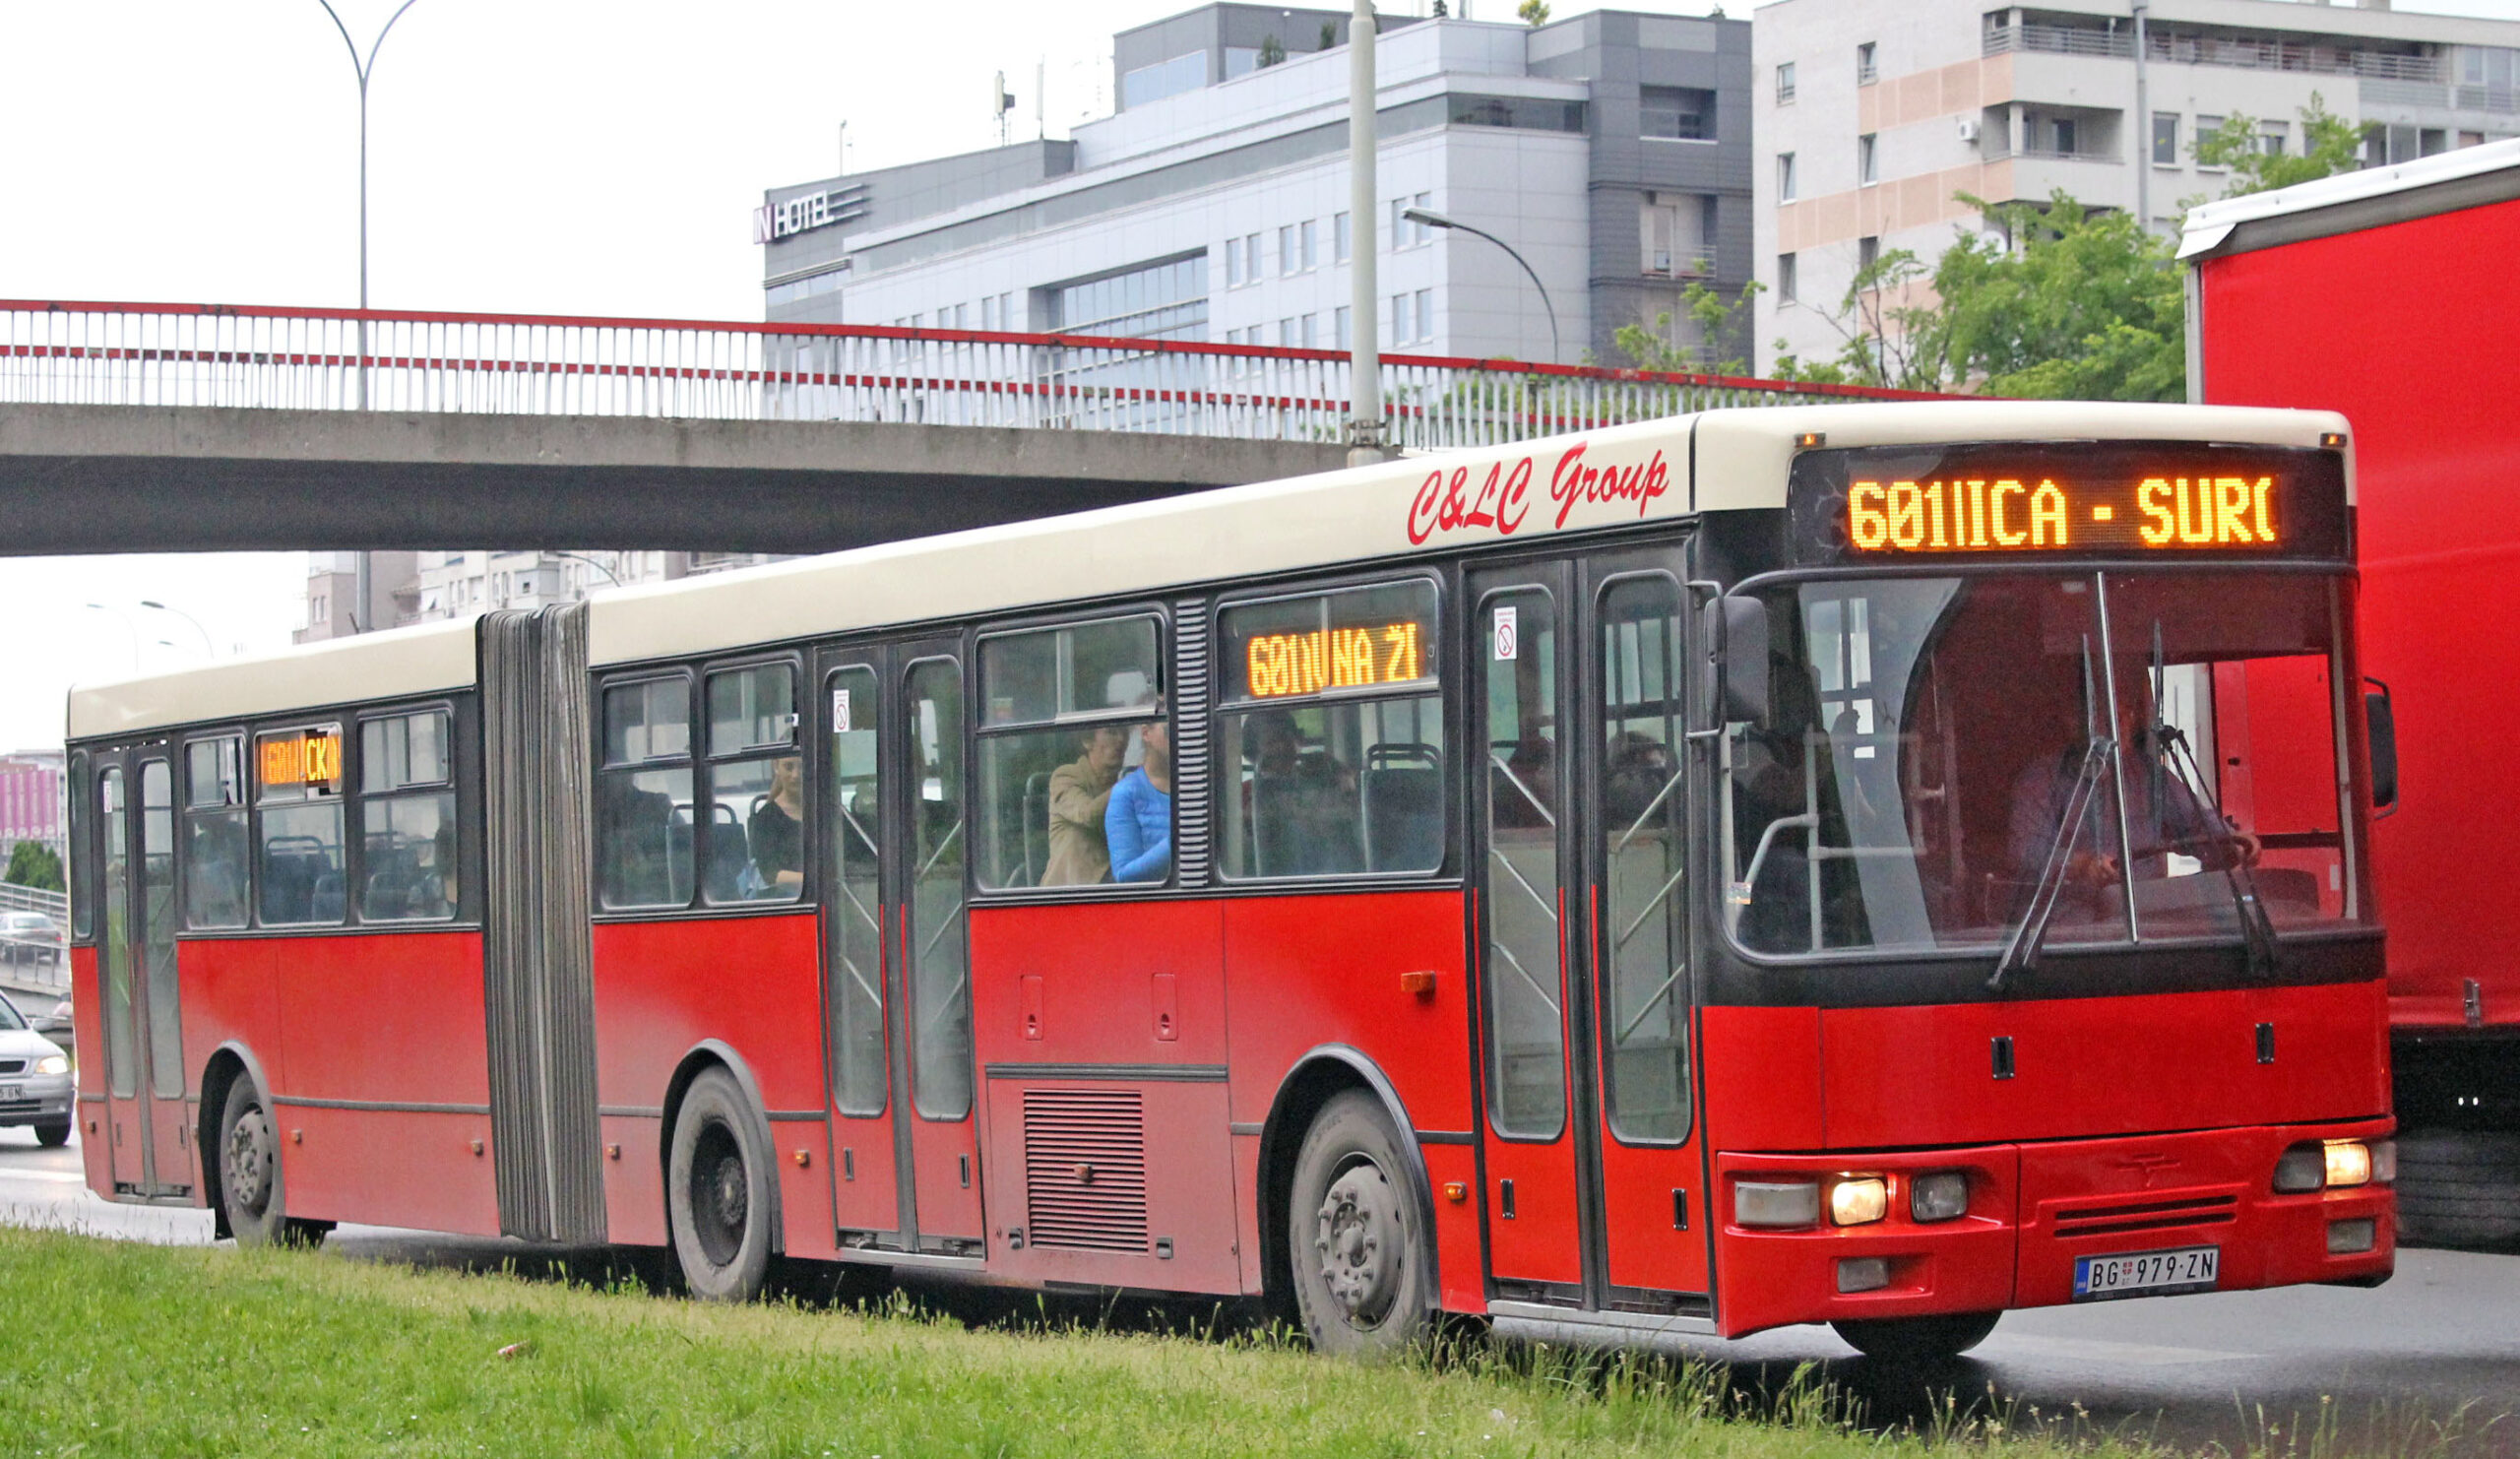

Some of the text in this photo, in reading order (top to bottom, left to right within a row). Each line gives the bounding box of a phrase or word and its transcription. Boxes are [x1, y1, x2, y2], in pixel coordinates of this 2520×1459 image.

[775, 190, 835, 237] HOTEL
[1408, 440, 1670, 544] C&LC Group
[2092, 1261, 2118, 1289] BG
